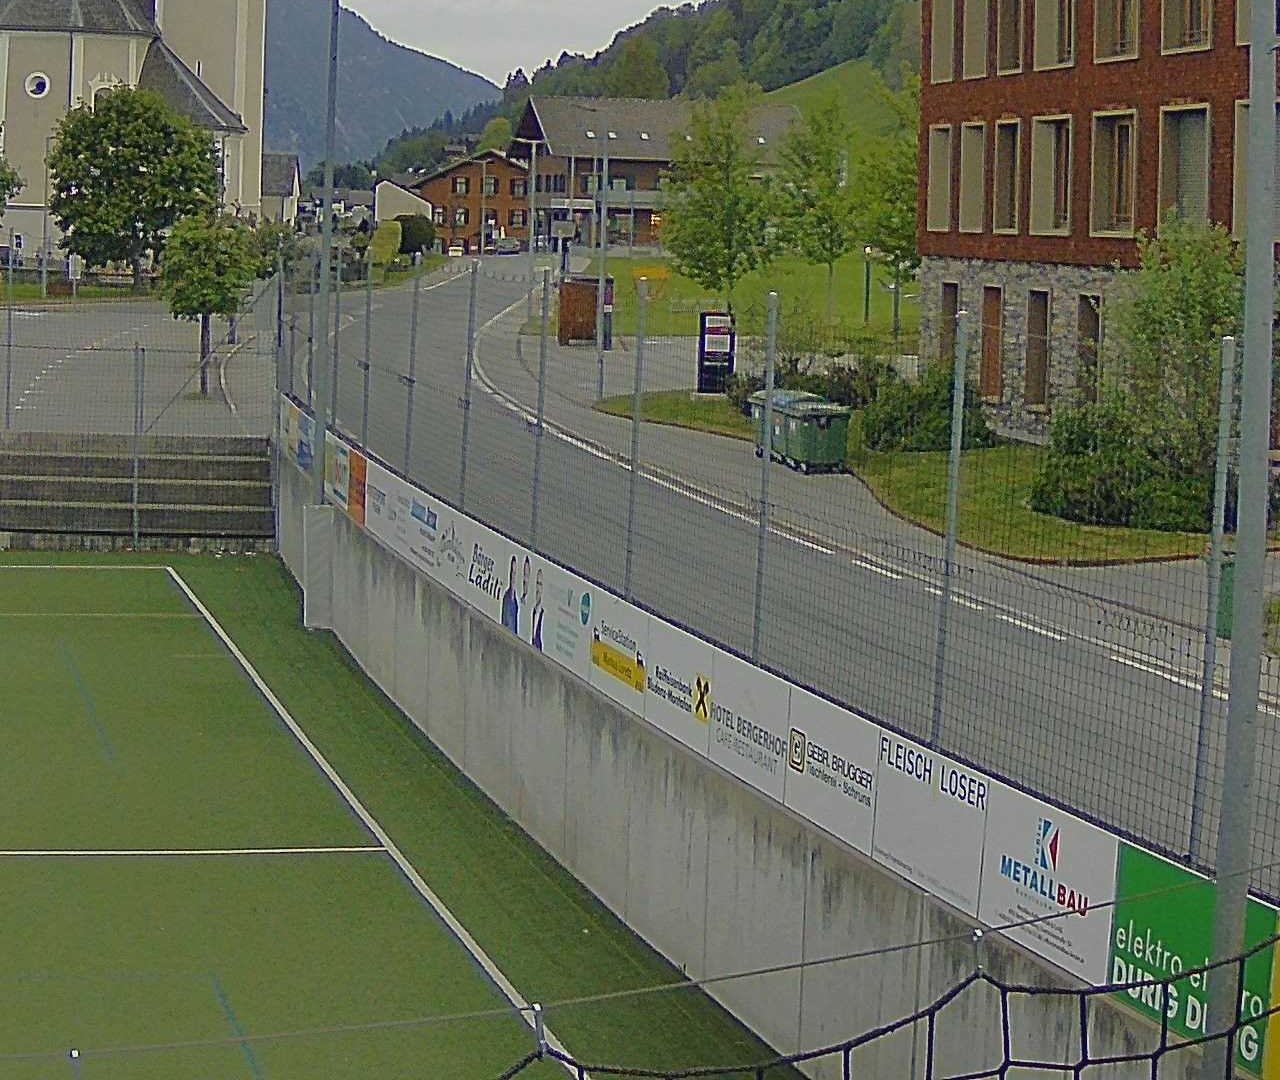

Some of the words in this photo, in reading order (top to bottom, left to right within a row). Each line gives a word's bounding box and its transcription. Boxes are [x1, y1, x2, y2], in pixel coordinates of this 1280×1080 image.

[710, 702, 735, 731] HOTEL
[736, 715, 788, 758] BERGERHOF
[806, 741, 830, 768] GEBR.
[831, 754, 873, 792] BRUGGER
[880, 736, 933, 785] FLEISCH
[940, 764, 987, 811] LOSER
[1000, 854, 1089, 917] METALLBAU
[1116, 919, 1182, 975] elektro
[1189, 956, 1263, 1018] elro
